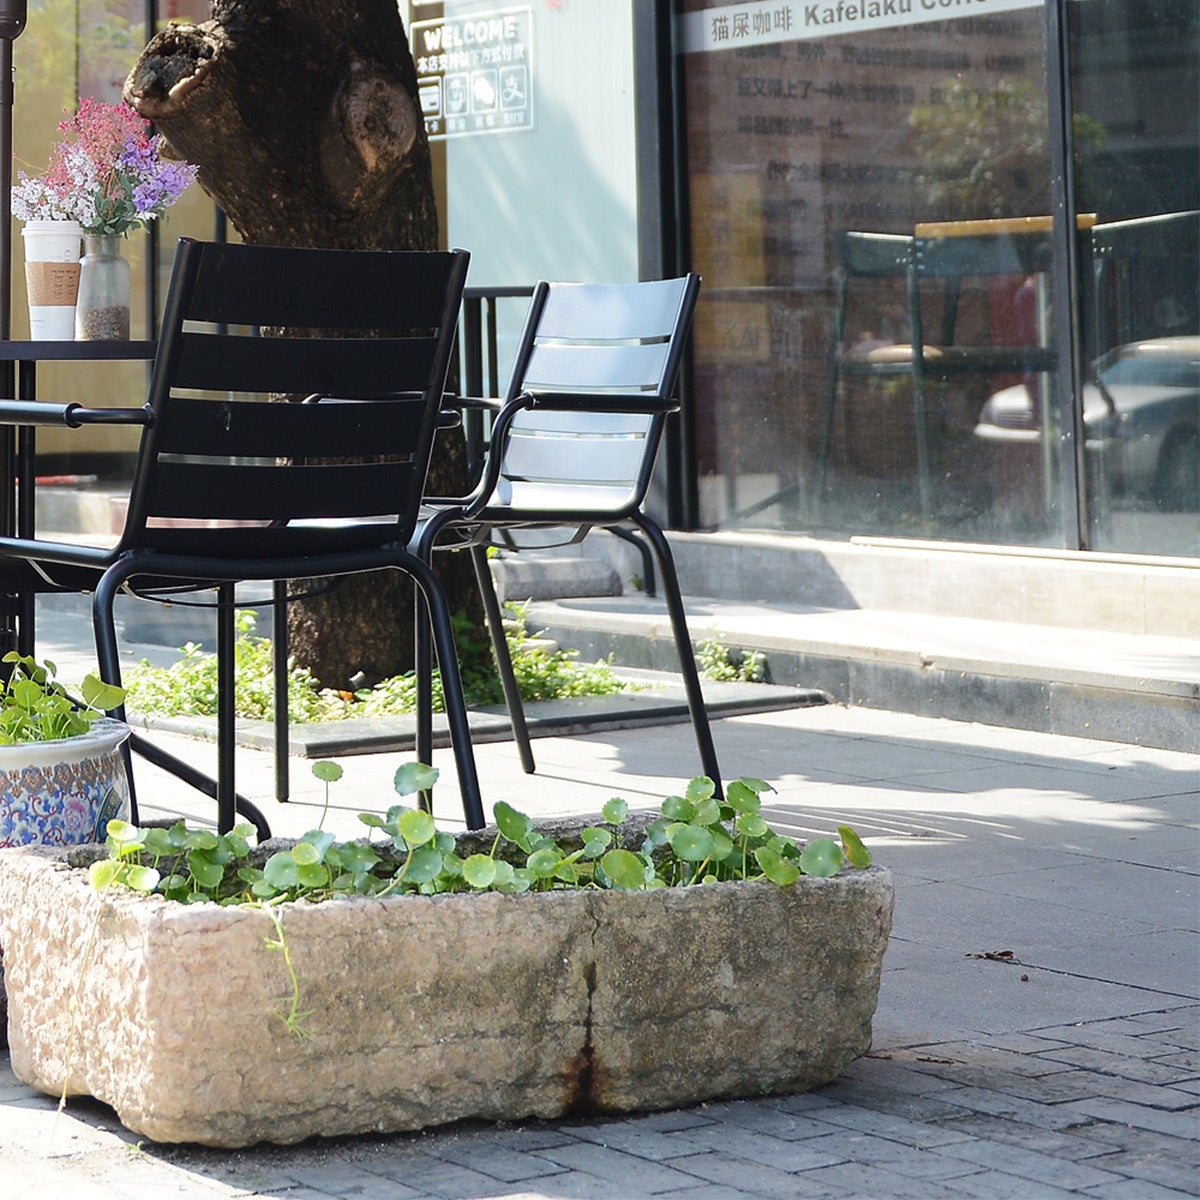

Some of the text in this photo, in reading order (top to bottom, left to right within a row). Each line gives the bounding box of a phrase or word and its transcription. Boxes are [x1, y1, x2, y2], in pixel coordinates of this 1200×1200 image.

[423, 16, 517, 52] WELCOME
[710, 4, 793, 43] 猫屎咖啡
